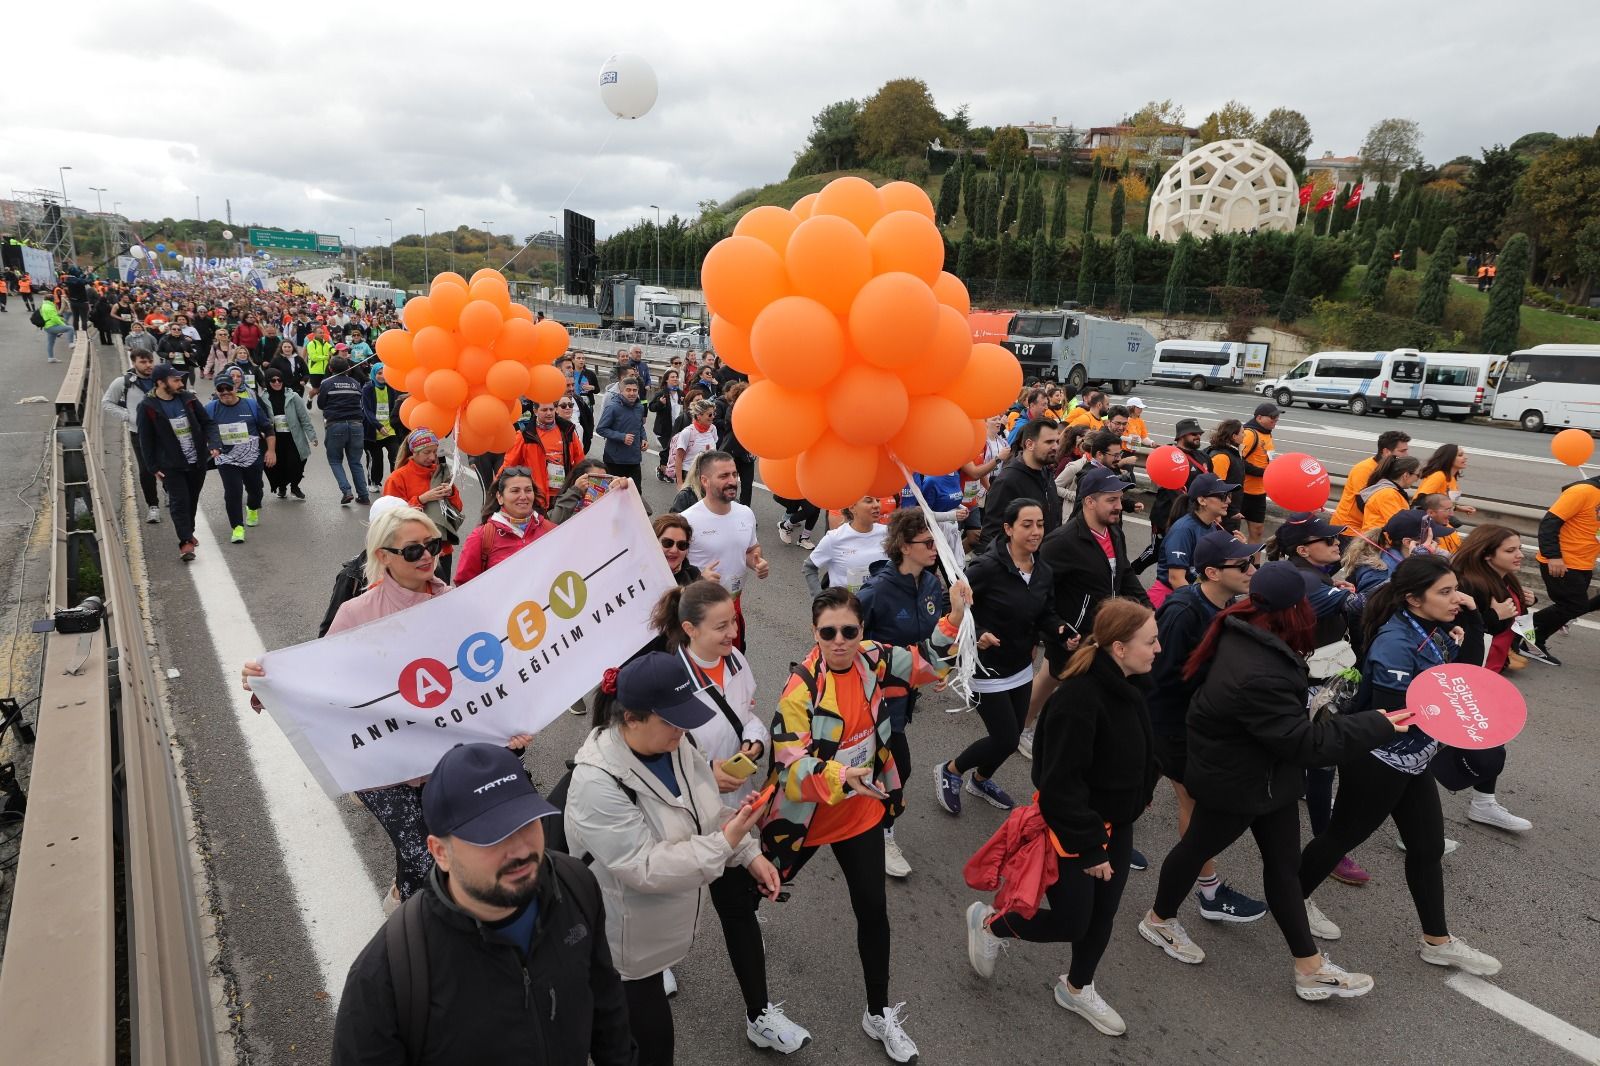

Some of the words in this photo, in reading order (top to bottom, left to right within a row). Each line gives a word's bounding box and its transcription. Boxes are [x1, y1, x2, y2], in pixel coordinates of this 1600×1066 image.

[1014, 343, 1020, 354] T
[1021, 343, 1035, 355] 87
[1127, 342, 1140, 352] T87
[518, 625, 584, 683] EĞİTİM
[592, 579, 646, 624] VAKFI
[1431, 672, 1451, 690] Dur
[1443, 691, 1471, 721] Durak
[1463, 724, 1485, 742] Yok
[1451, 676, 1489, 730] Eğitimde
[473, 773, 517, 794] TATKO
